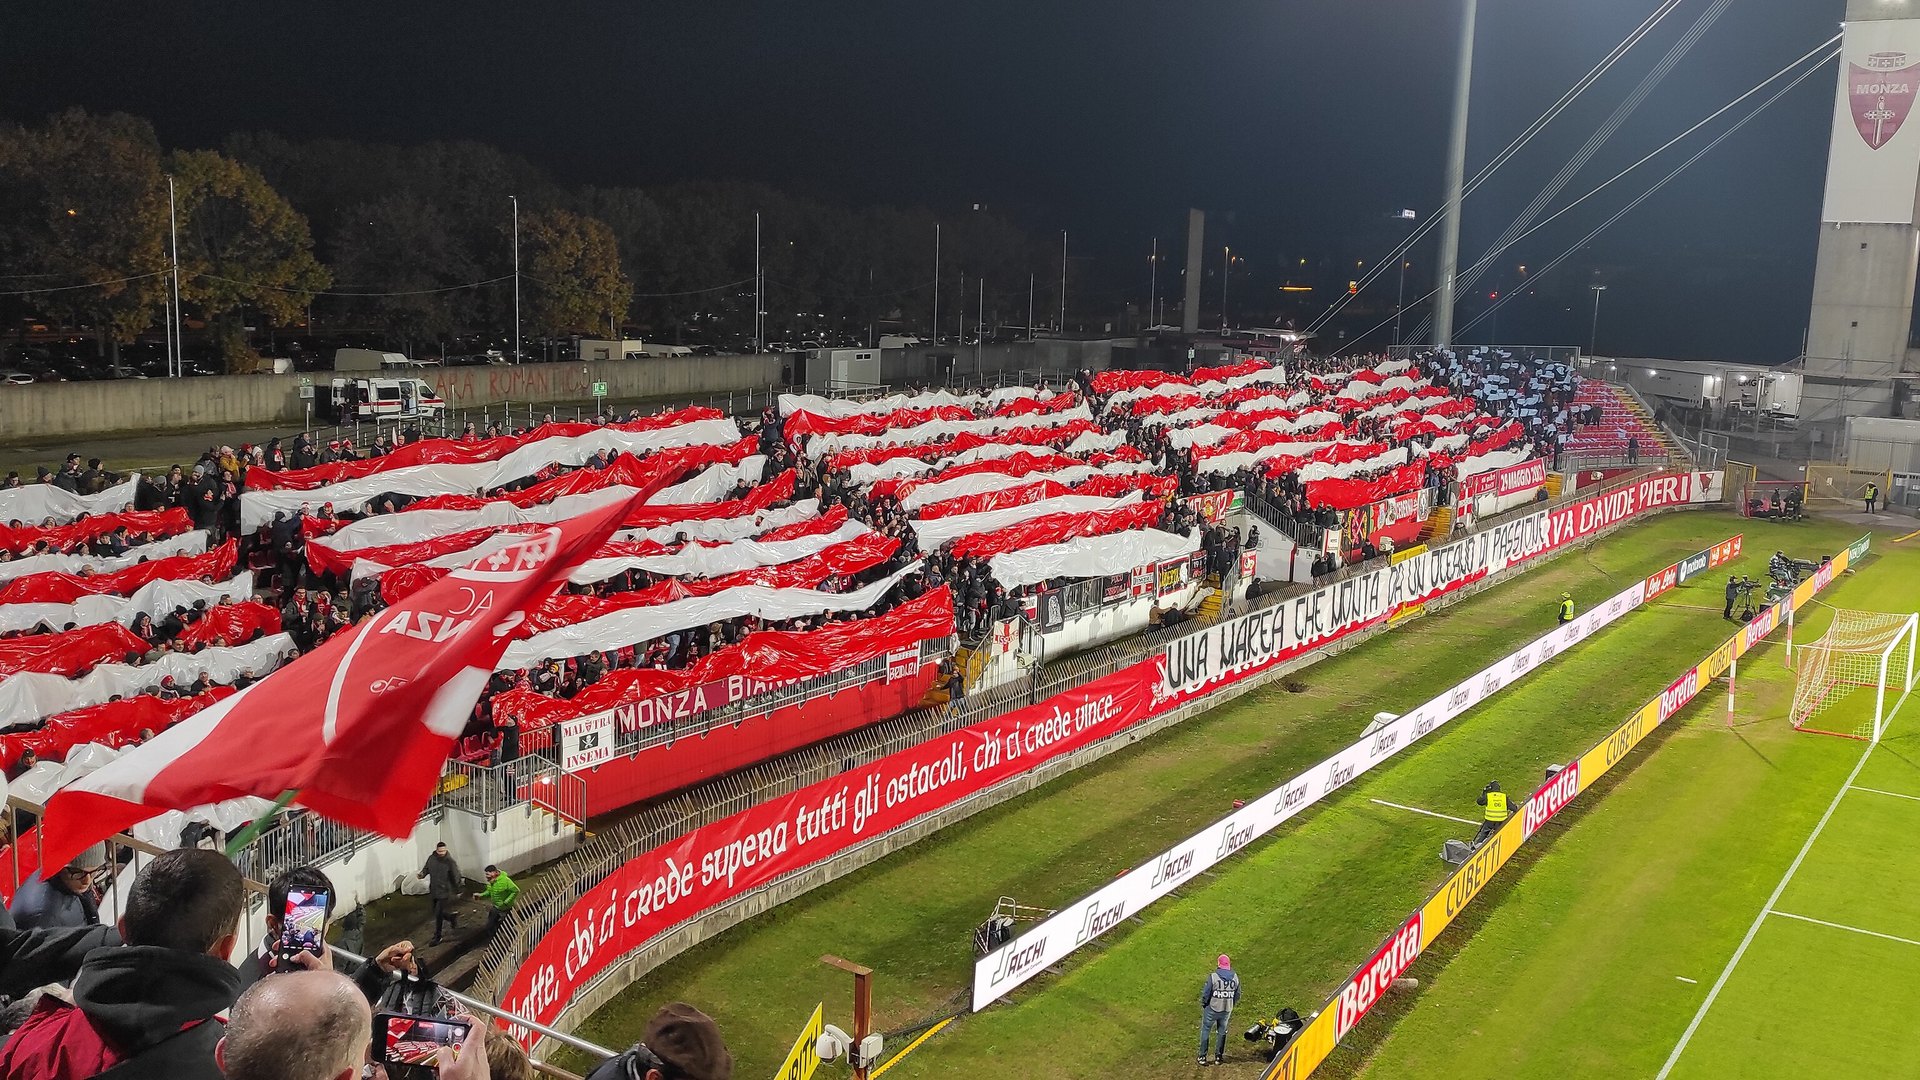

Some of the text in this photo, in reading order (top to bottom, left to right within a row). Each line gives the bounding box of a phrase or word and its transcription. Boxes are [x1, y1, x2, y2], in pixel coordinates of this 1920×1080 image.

[1856, 84, 1909, 94] MONZA
[423, 372, 474, 400] ARA
[1508, 467, 1531, 490] MAGGIO
[1579, 474, 1689, 534] DAVIDE PIERI
[1686, 554, 1707, 575] motorola
[1167, 631, 1209, 689] UNA
[1219, 605, 1285, 671] MAREA
[1294, 590, 1326, 640] CHE
[1331, 571, 1380, 632] MONTA
[1387, 563, 1405, 606] DA
[1407, 554, 1427, 596] UN
[1430, 537, 1475, 588] OCEANO
[1478, 532, 1489, 567] DI
[1746, 612, 1771, 650] Beretta
[617, 687, 708, 734] MONZA
[1660, 671, 1697, 719] Beretta
[1370, 727, 1398, 758] SACCHI
[1410, 712, 1435, 742] SACCHI
[1606, 712, 1644, 767] CUBETTI
[566, 746, 610, 768] INSEMA
[1324, 761, 1355, 794] SACCHI
[1274, 782, 1308, 816] SACCHI
[1525, 768, 1578, 839] Beretta
[598, 888, 618, 947] ci
[623, 857, 695, 929] crede
[701, 820, 789, 889] supera
[795, 786, 849, 846] tutti
[852, 773, 881, 835] gli
[885, 741, 967, 809] ostacoli,
[973, 729, 1001, 773] chi
[1006, 721, 1022, 761] ci
[1025, 705, 1071, 754] crede
[1075, 692, 1123, 733] vince...
[1216, 822, 1255, 860] SACCHI
[1151, 849, 1194, 890] SACCHI
[1445, 835, 1503, 918] CUBETTI
[1076, 900, 1126, 946] SACCHI
[991, 936, 1047, 988] SACCHI
[1338, 923, 1420, 1039] Beretta
[1217, 980, 1236, 990] 190
